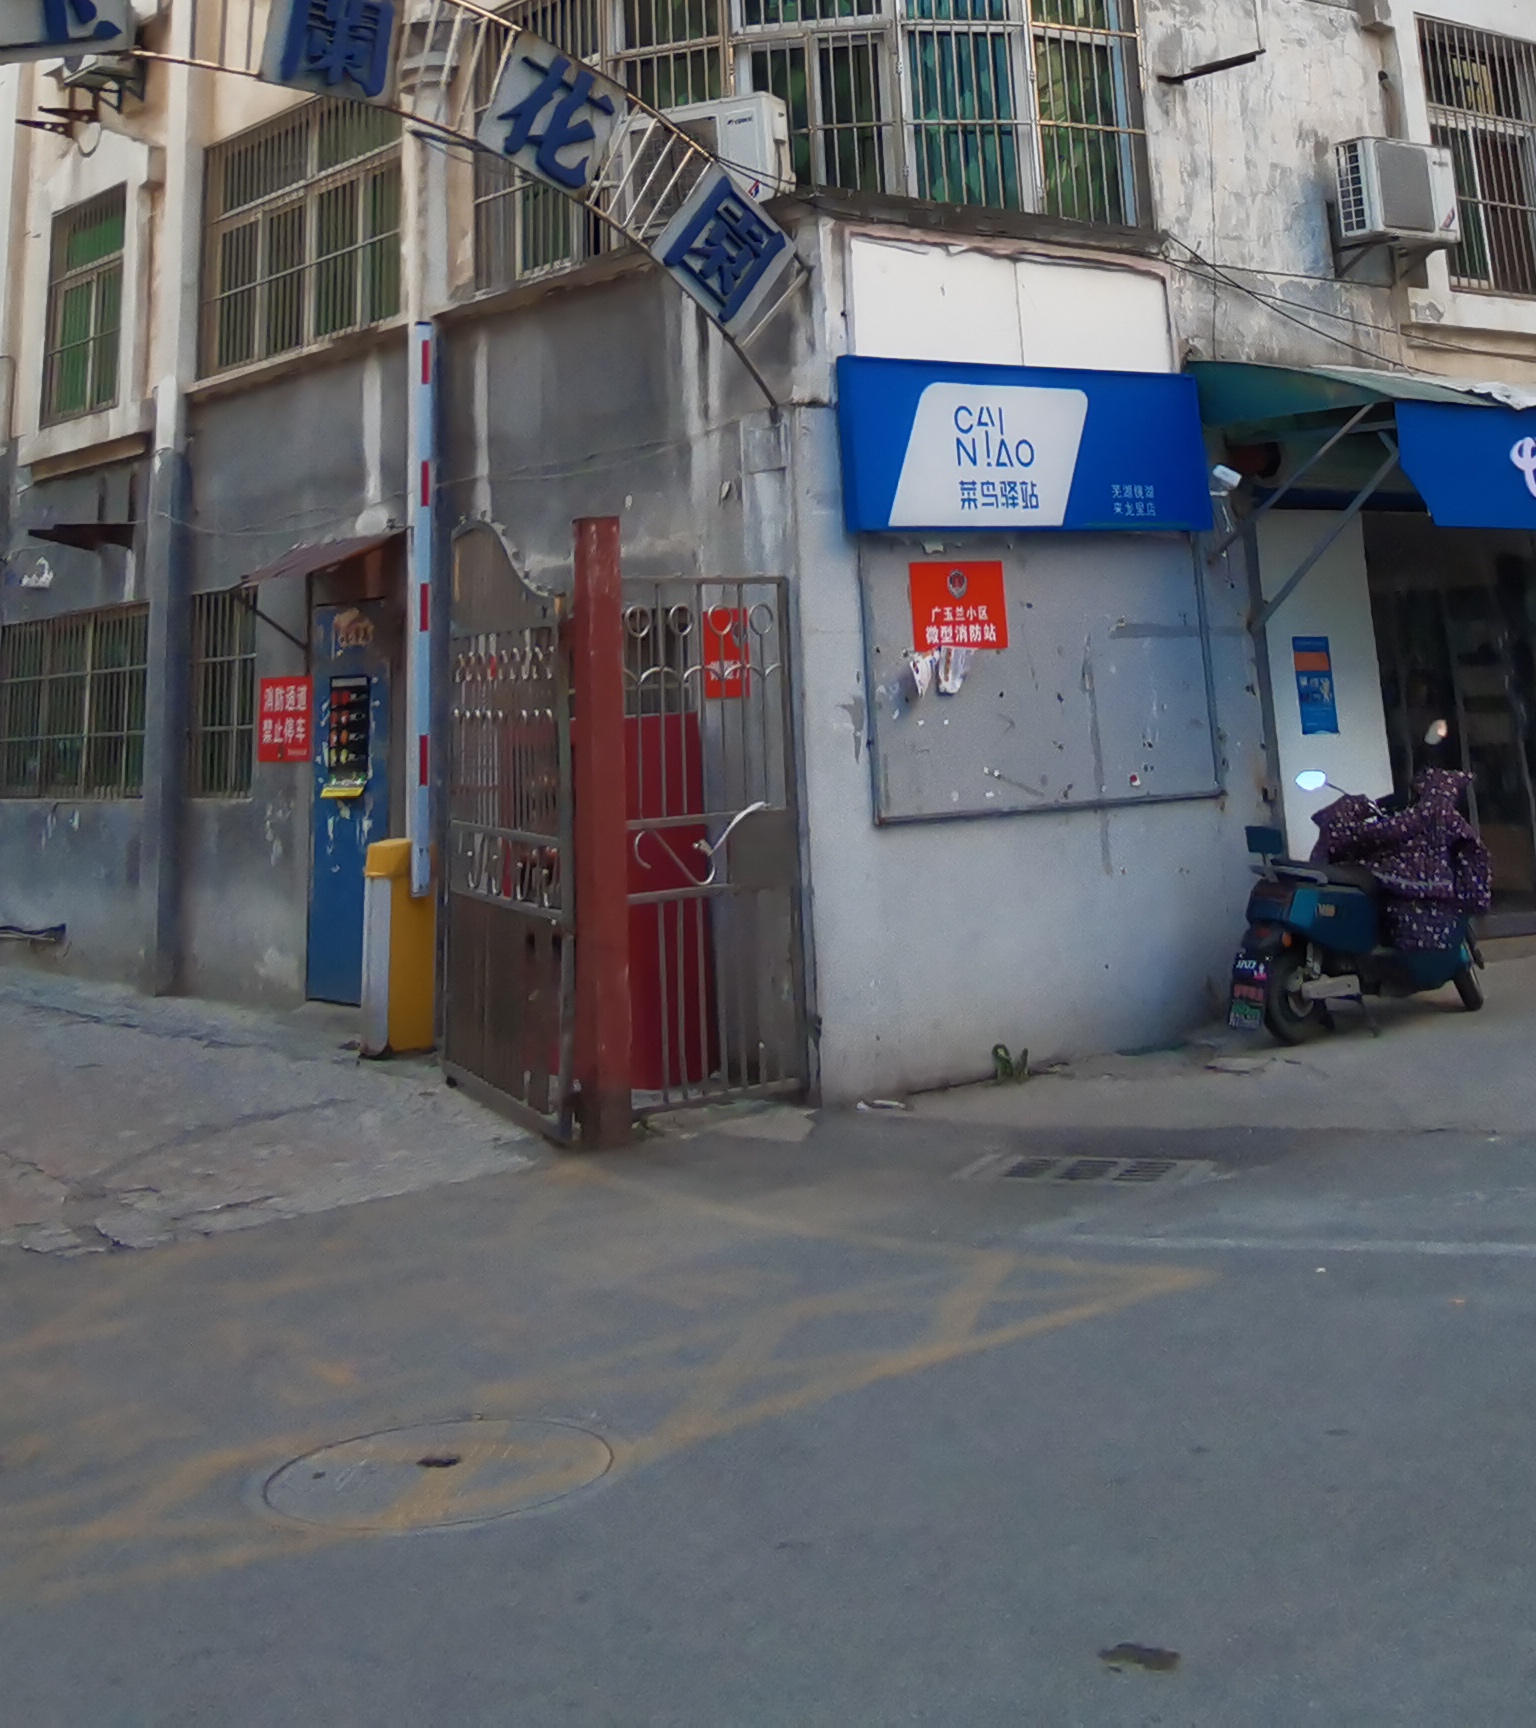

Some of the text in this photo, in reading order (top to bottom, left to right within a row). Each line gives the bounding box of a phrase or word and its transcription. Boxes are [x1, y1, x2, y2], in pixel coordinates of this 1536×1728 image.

[954, 405, 1004, 436] CAI
[959, 480, 1040, 510] 菜鸟驿站
[931, 605, 989, 623] 广玉兰小区
[925, 623, 997, 645] 微型消防站
